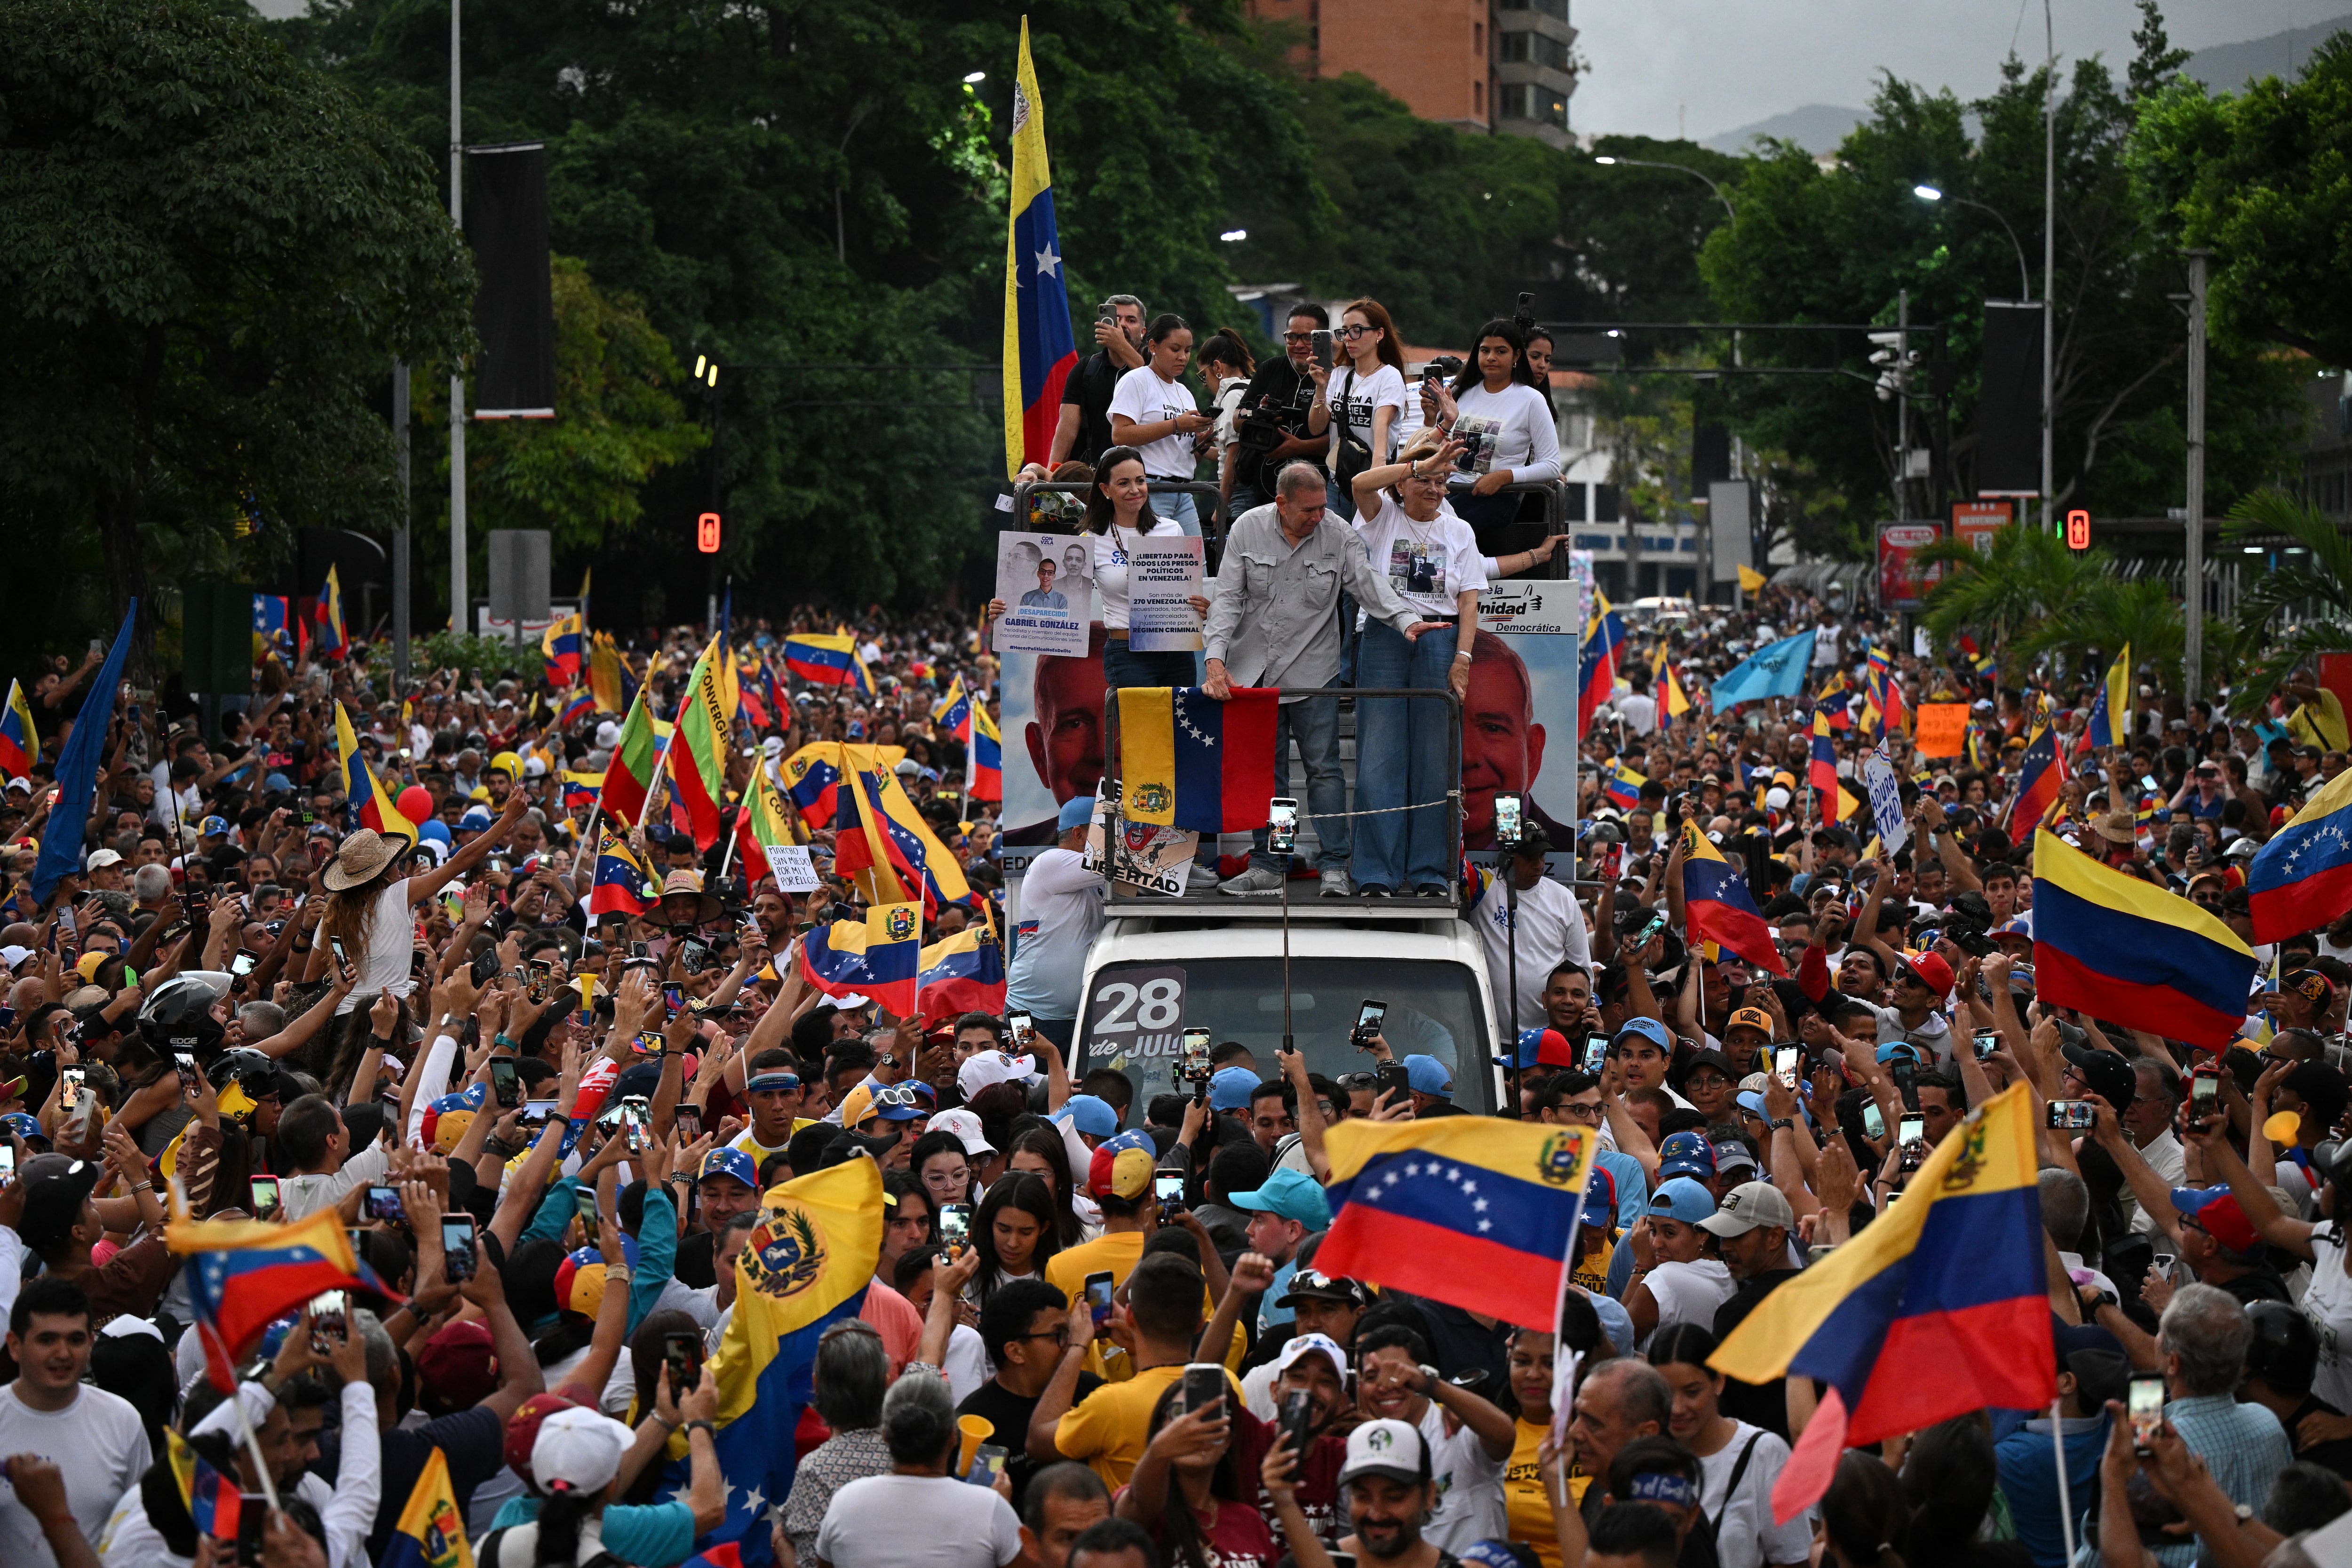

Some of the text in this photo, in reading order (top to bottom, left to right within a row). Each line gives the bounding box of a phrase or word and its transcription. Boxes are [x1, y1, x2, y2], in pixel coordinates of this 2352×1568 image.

[1494, 585, 1503, 595] la
[1017, 608, 1068, 617] ¡DESAPARECIDO!
[1005, 618, 1079, 630] GABRIEL GONZÁLEZ
[1495, 623, 1560, 632] Democrática
[703, 668, 728, 743] CONVERGE
[1871, 773, 1895, 813] ADURO
[773, 857, 810, 866] SIN MIEDO
[777, 866, 791, 876] POR
[802, 867, 807, 876] Y
[781, 876, 818, 886] POR ELLOS
[1093, 978, 1181, 1035] 28
[1089, 1039, 1118, 1057] de
